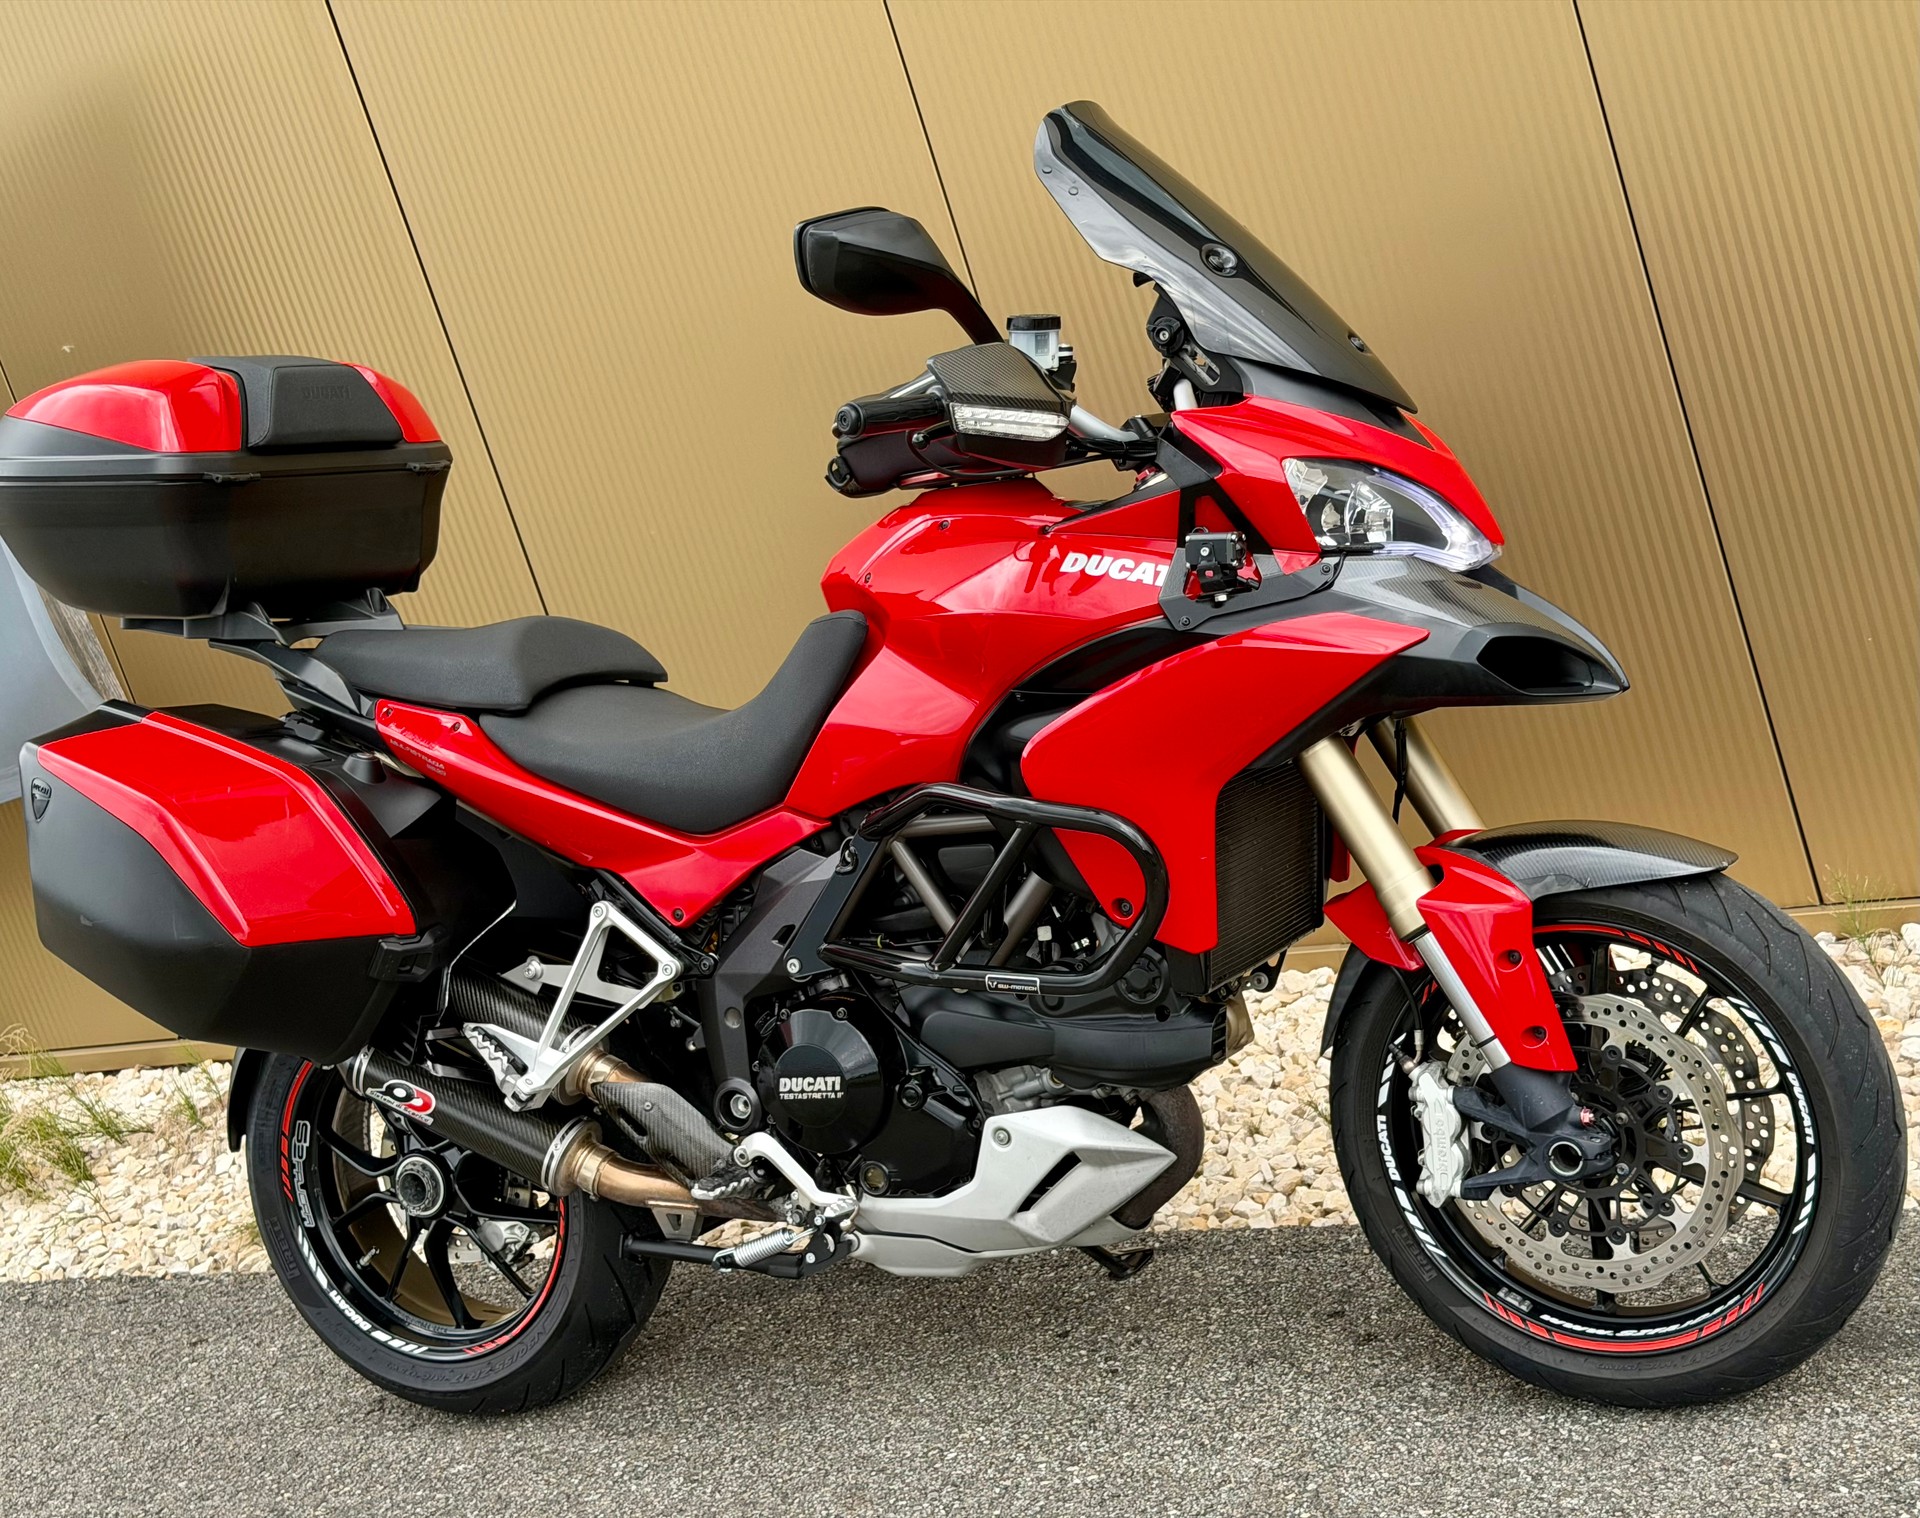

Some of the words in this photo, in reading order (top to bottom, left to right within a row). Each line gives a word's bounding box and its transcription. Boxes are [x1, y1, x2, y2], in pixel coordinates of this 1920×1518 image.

[1059, 552, 1170, 587] DUCAT
[779, 1076, 841, 1092] DUCATI
[779, 1092, 836, 1100] TESTASTRETTA
[1786, 1071, 1816, 1146] DUCATI
[1376, 1114, 1402, 1182] DUCATI
[328, 1289, 373, 1332] DUCATI
